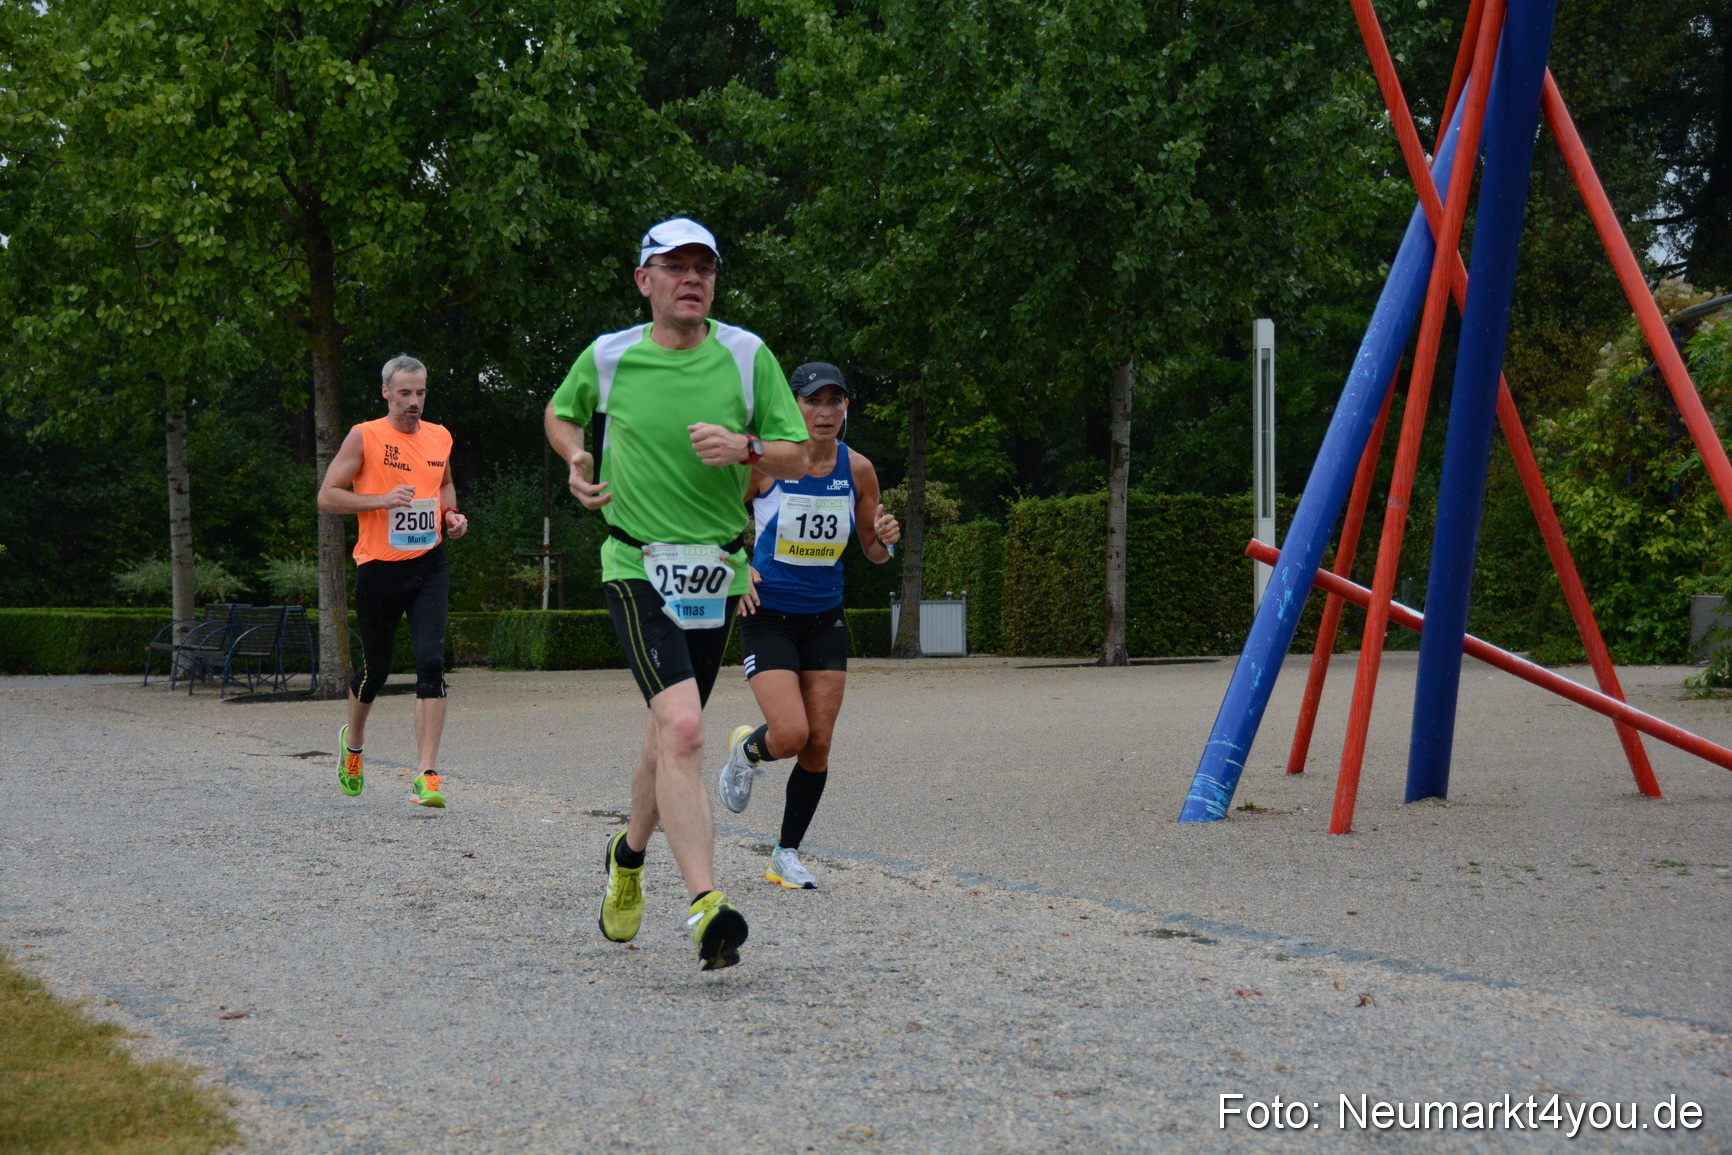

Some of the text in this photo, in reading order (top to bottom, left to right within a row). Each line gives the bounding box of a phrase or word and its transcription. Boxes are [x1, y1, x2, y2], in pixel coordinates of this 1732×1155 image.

[384, 458, 411, 471] DANIEL
[395, 511, 435, 531] 2500
[796, 513, 838, 539] 133
[407, 535, 427, 543] Muris
[788, 544, 835, 556] Alexandra
[656, 564, 727, 596] 2590
